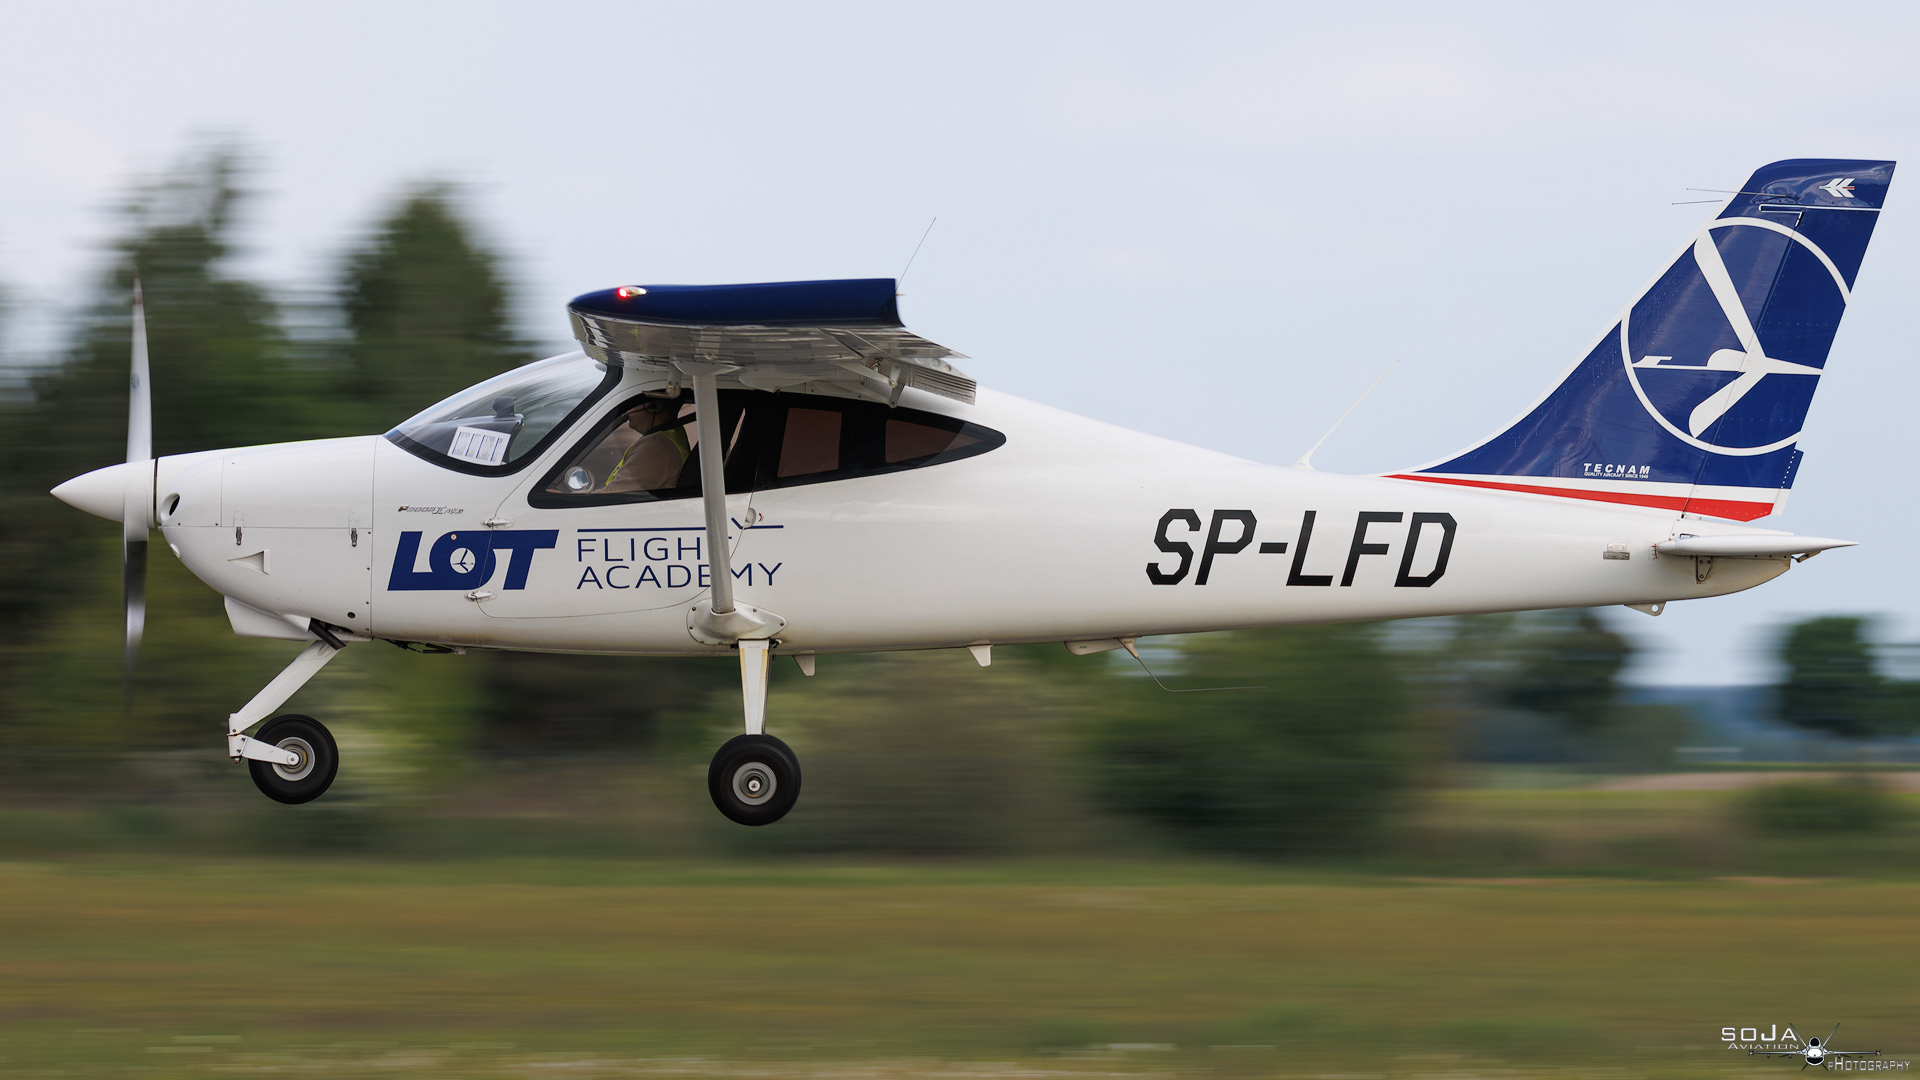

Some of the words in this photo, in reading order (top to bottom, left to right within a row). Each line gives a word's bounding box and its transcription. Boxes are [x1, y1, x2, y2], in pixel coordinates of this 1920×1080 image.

[1584, 463, 1650, 475] TECNAM
[387, 530, 559, 591] LOT
[577, 536, 733, 562] FLIGH
[1145, 508, 1458, 588] SP-LFD
[576, 562, 783, 590] ACADEMY
